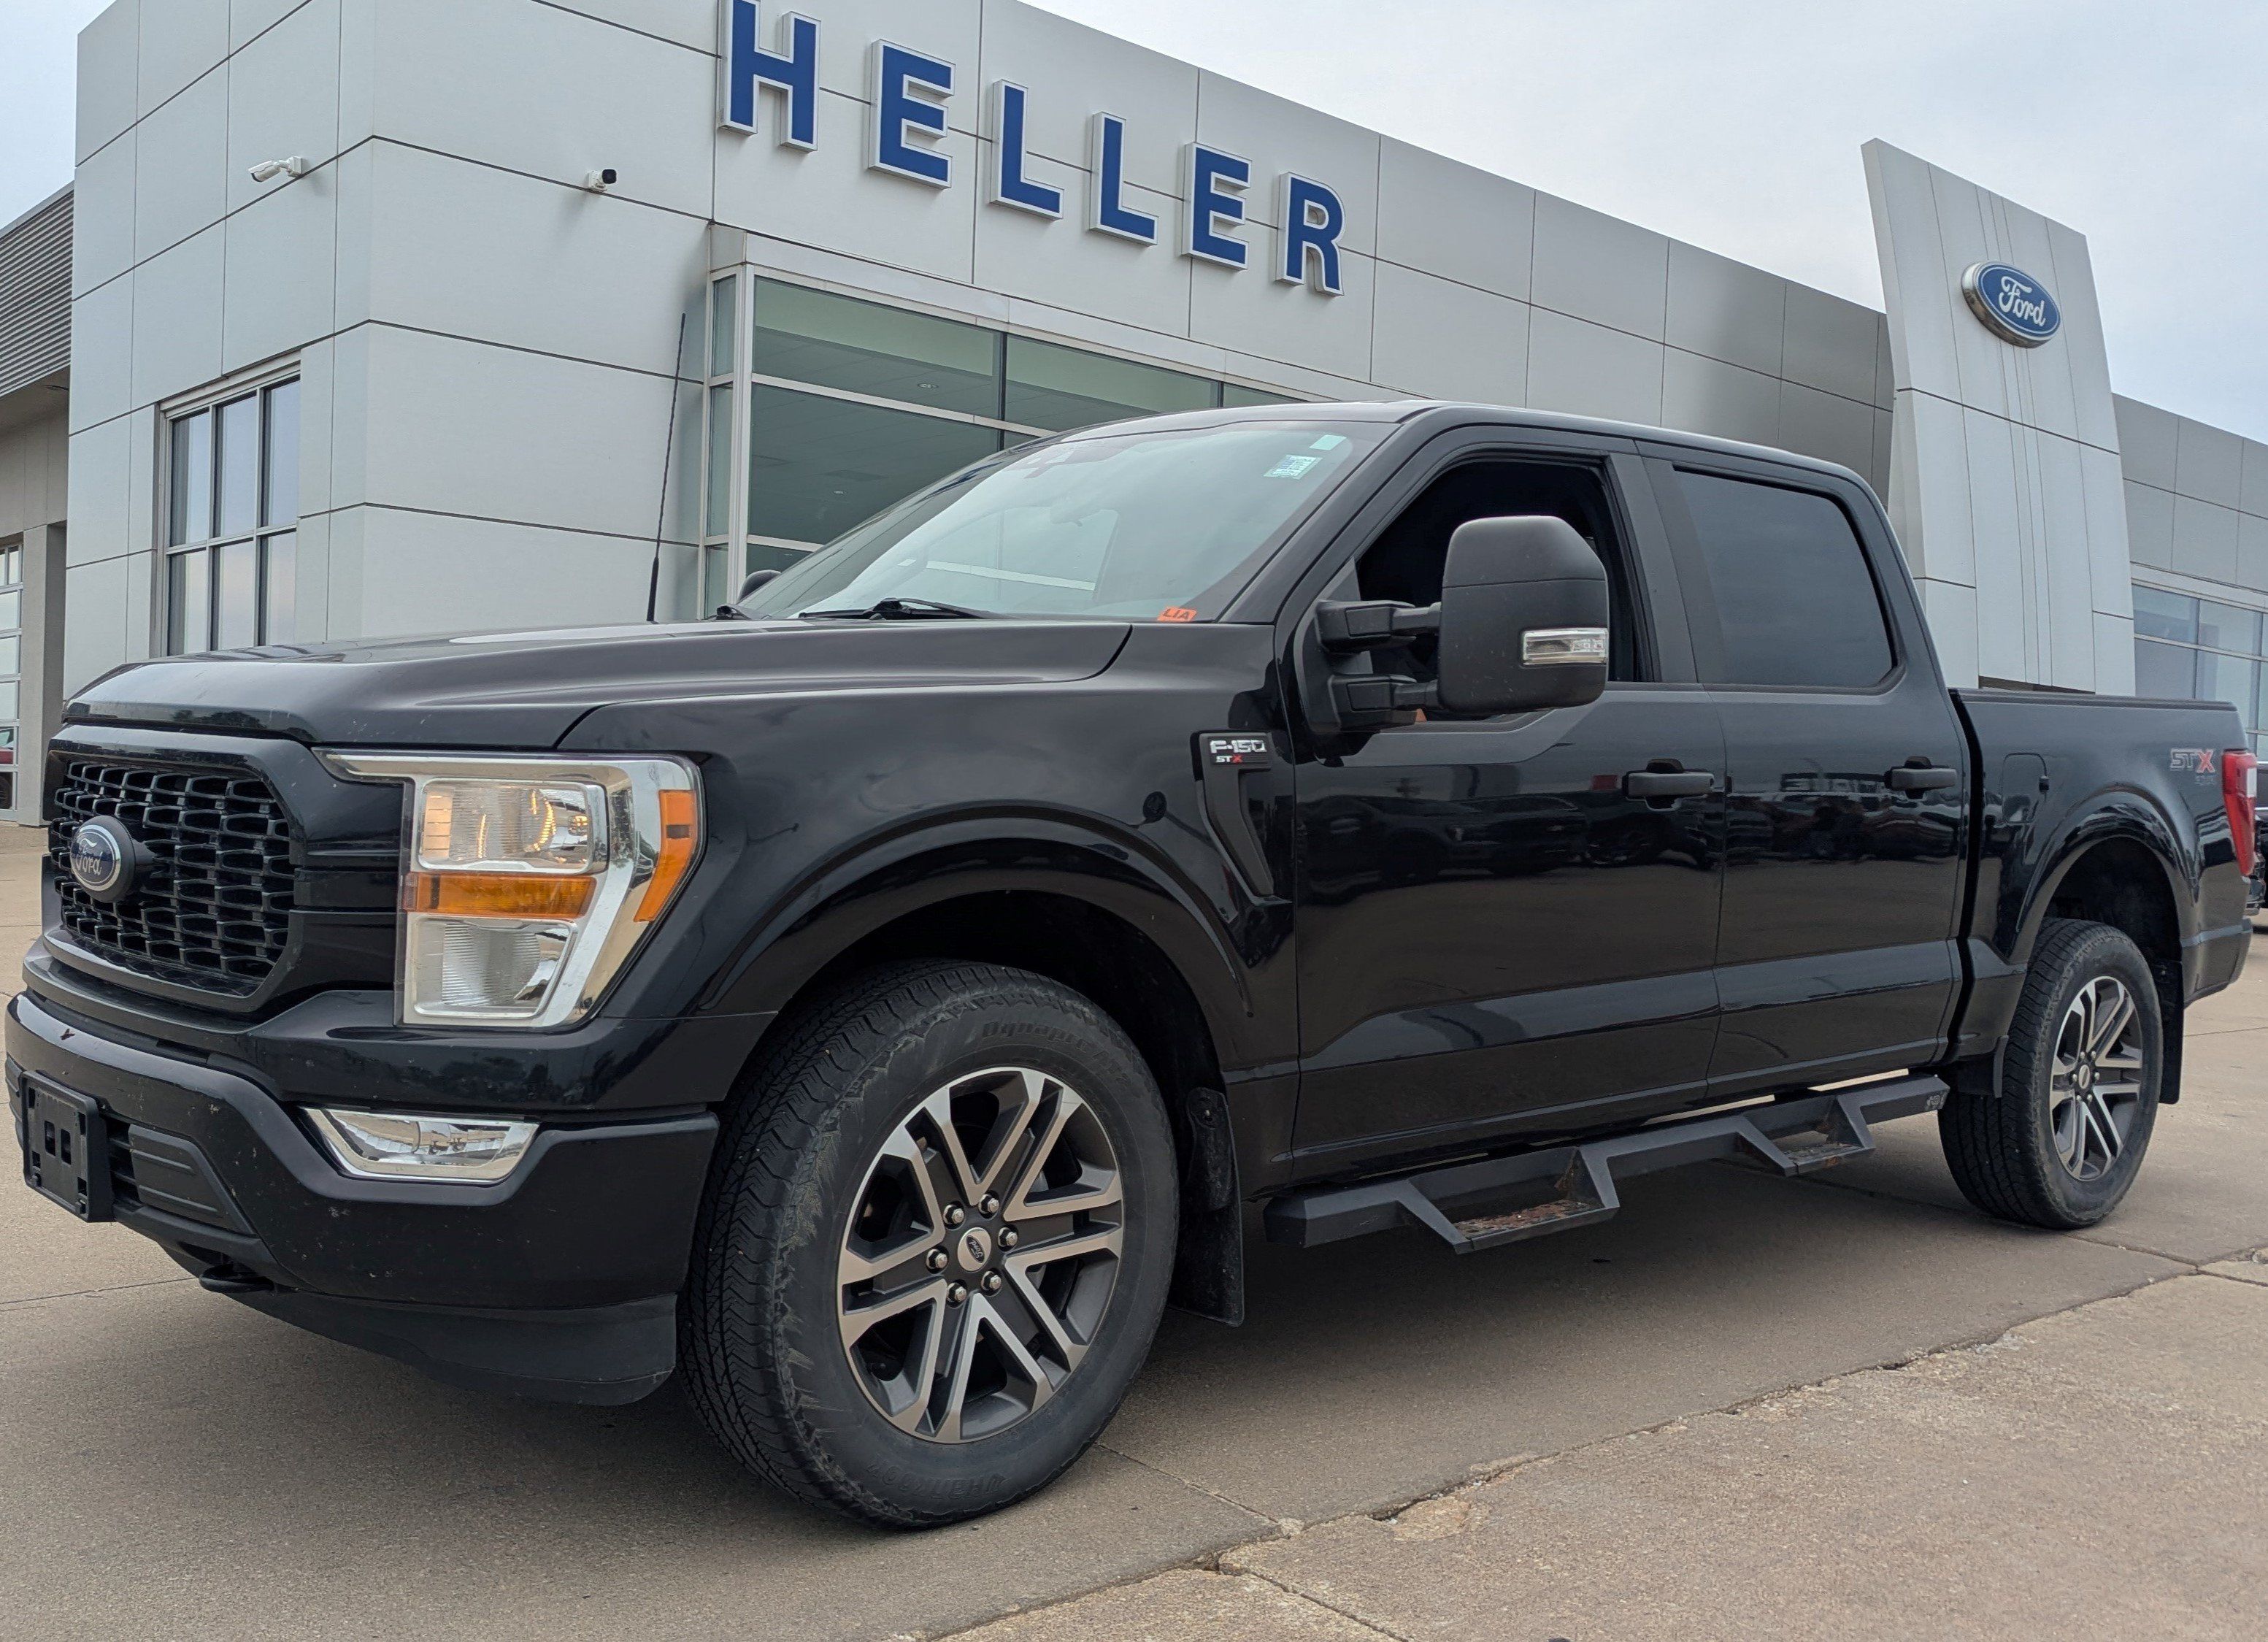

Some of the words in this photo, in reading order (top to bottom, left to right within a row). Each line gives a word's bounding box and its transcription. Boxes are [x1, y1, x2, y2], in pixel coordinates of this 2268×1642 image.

[720, 0, 1345, 296] HELLER
[1998, 275, 2047, 327] Ford
[1210, 739, 1267, 753] F-150
[1215, 755, 1243, 763] STX
[2169, 748, 2216, 773] STX
[74, 837, 104, 876] Ford
